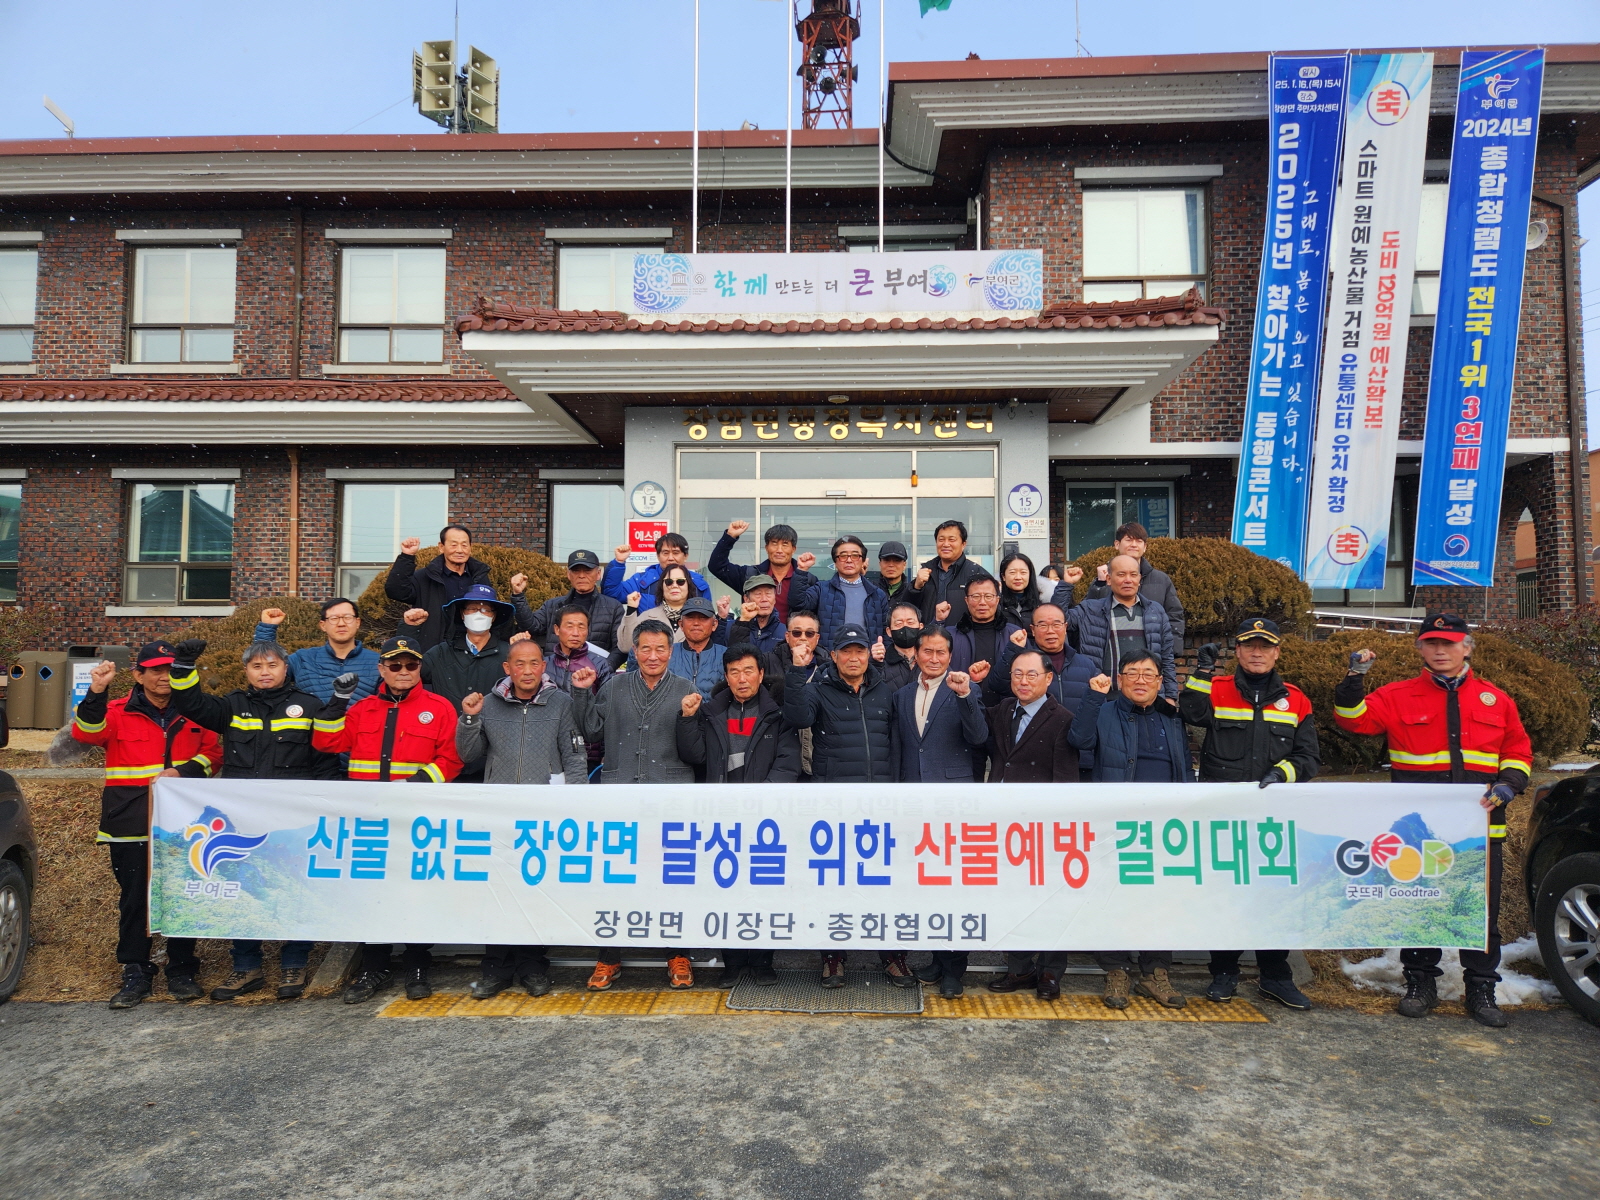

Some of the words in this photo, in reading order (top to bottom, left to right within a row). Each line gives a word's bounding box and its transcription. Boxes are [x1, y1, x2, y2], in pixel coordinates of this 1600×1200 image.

[1375, 88, 1402, 117] 축
[1481, 98, 1518, 110] 부여군
[1461, 117, 1533, 138] 2024년
[1355, 139, 1378, 200] 스마트
[1271, 122, 1300, 270] 2025년
[1470, 145, 1508, 277] 종합청렴도
[1345, 205, 1372, 305] 원예농산물
[1379, 230, 1400, 269] 도비
[713, 269, 768, 297] 함께
[774, 280, 814, 295] 만드는
[824, 279, 839, 294] 더
[848, 268, 875, 297] 큰
[883, 268, 928, 296] 부여
[986, 275, 1019, 286] 부여군
[1294, 269, 1312, 314] 봄은
[1372, 273, 1397, 341] 120억원
[1258, 284, 1292, 397] 찾아가는
[1342, 310, 1362, 348] 거점
[1289, 330, 1308, 369] 오고
[1334, 353, 1358, 430] 유통센터
[682, 407, 993, 441] 장암면행정복지센터
[1451, 395, 1483, 471] 3연패
[1331, 434, 1351, 472] 유치
[1241, 411, 1278, 546] 동행콘서트
[1327, 476, 1348, 514] 확정
[641, 495, 656, 506] 15
[1018, 497, 1032, 507] 15
[1446, 478, 1478, 526] 달성
[634, 530, 662, 541] 에스원
[1335, 533, 1360, 557] 축
[307, 816, 390, 880] 산불
[411, 815, 492, 882] 없는
[514, 818, 638, 886] 장암면
[662, 818, 788, 889] 달성을
[808, 819, 896, 886] 위한
[914, 821, 1096, 889] 산불예방
[1115, 817, 1298, 886] 결의대회
[184, 880, 241, 899] 부여군
[1346, 886, 1383, 899] 굿뜨래
[1389, 886, 1440, 898] Goodtrae
[593, 910, 684, 940] 장암면
